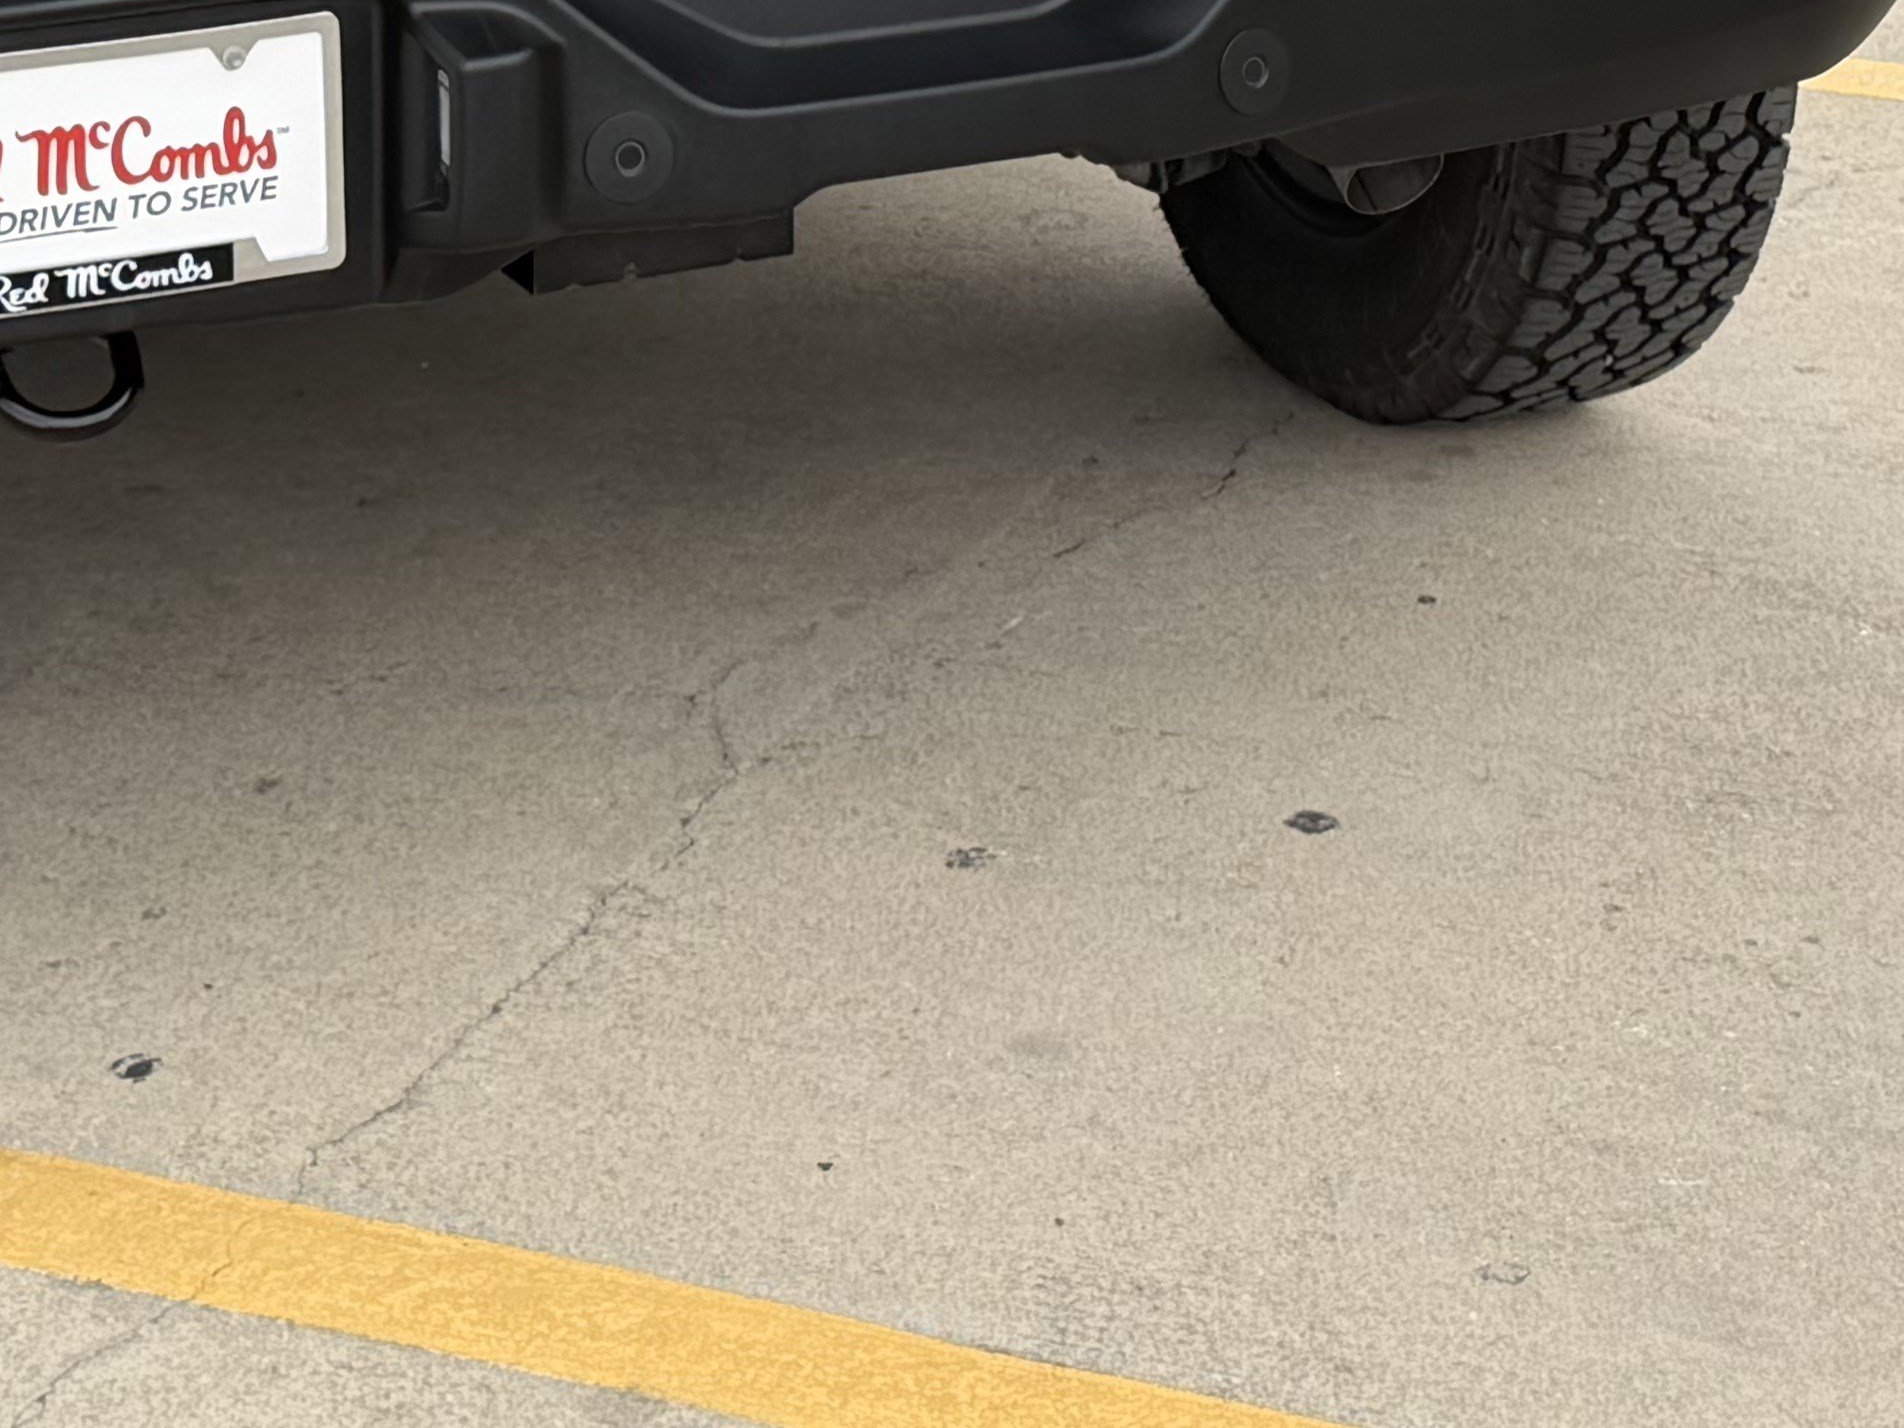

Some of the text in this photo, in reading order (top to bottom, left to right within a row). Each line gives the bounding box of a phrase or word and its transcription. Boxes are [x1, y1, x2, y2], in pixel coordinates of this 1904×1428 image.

[15, 105, 278, 197] McCombs
[128, 191, 172, 219] TO
[181, 175, 279, 212] SERVE
[54, 252, 214, 300] McCombs
